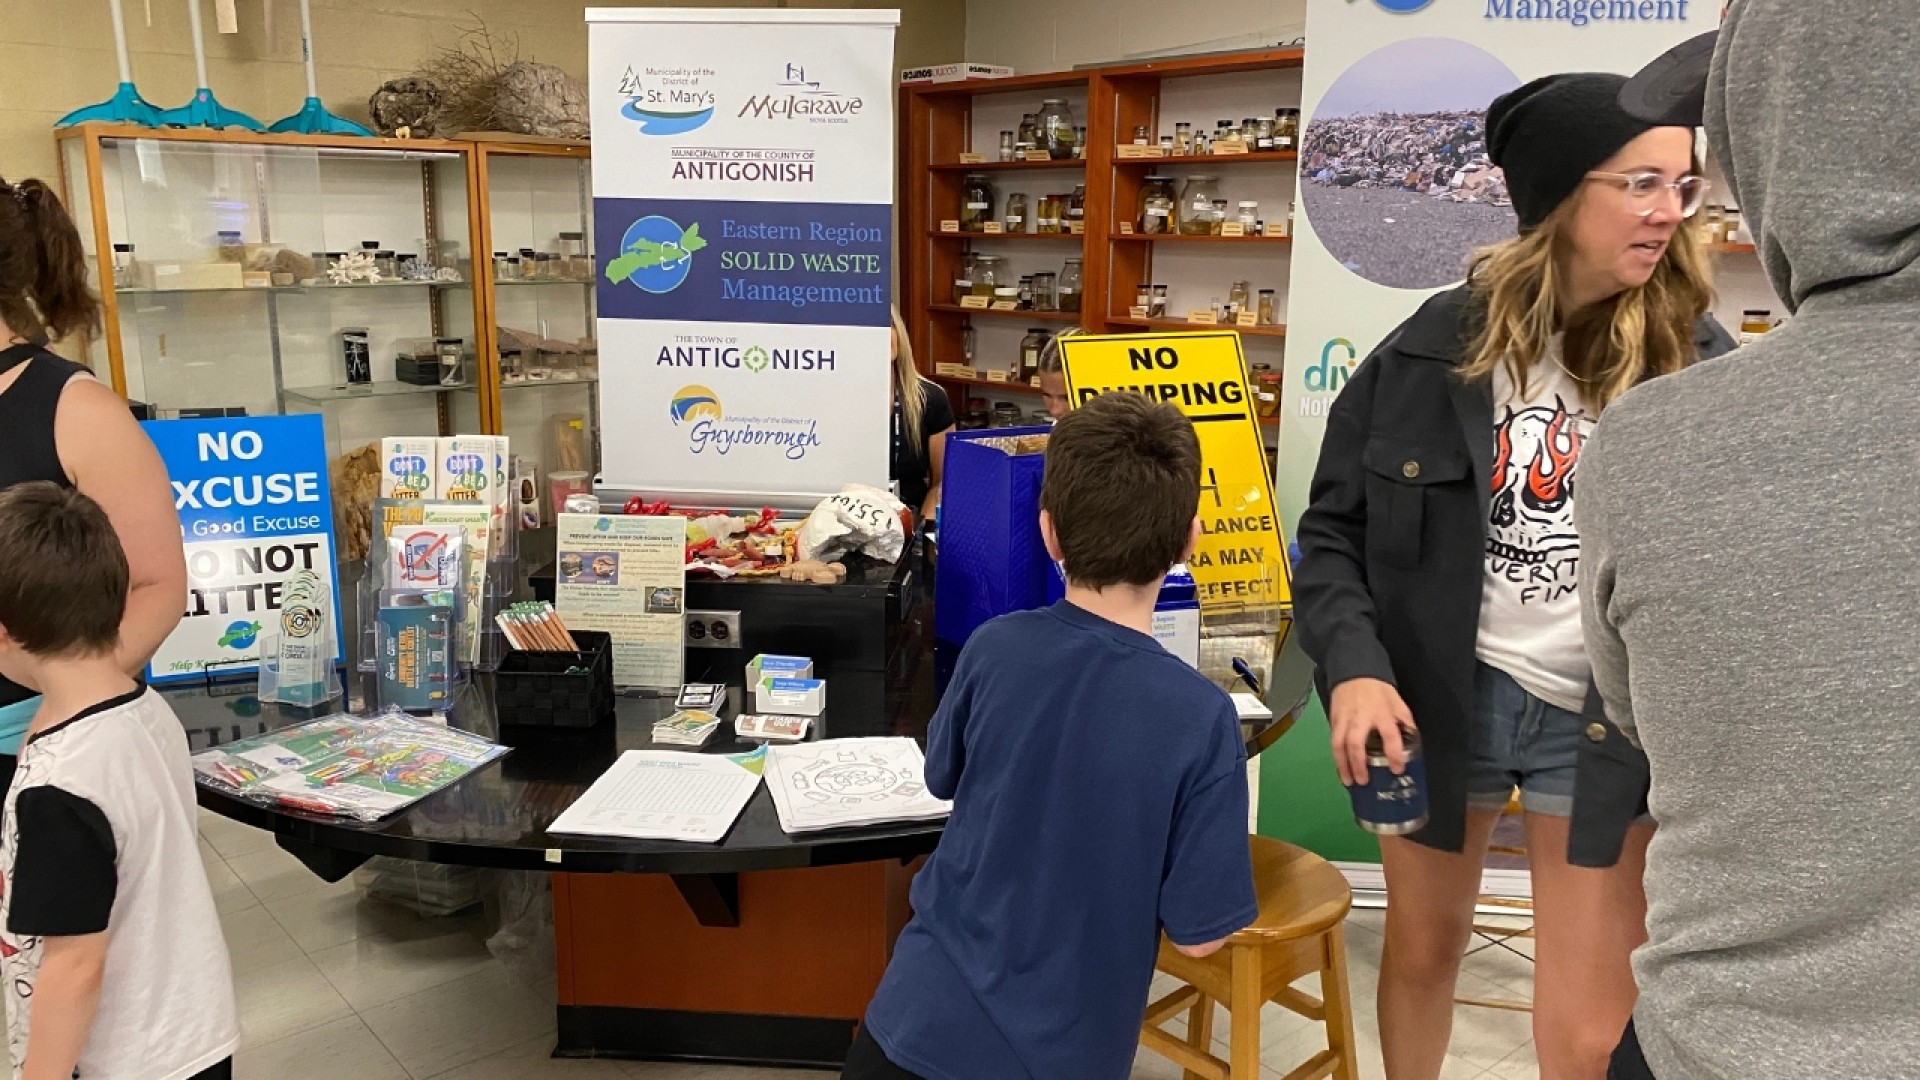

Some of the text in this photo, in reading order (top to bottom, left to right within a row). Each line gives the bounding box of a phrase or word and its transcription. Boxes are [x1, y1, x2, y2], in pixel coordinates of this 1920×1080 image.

[1483, 0, 1688, 26] Management
[646, 67, 715, 77] Municipality of the
[662, 76, 699, 85] District of
[647, 90, 715, 107] St. Mary's
[671, 149, 815, 160] MUNICIPALITY OF THE COUNTY OF
[671, 161, 814, 182] ANTIGONISH
[722, 219, 883, 247] Eastern Region
[720, 251, 880, 274] SOLID WASTE
[721, 278, 884, 307] Management
[674, 335, 738, 344] THE TOWN OF
[1128, 347, 1179, 371] NO
[724, 415, 762, 424] Municipality
[781, 417, 802, 425] District
[197, 430, 263, 462] NO
[689, 420, 820, 460] Guysborough
[170, 471, 321, 511] XCUSE
[383, 506, 405, 521] THE
[192, 517, 246, 536] Good
[252, 514, 321, 532] Excuse
[1199, 515, 1273, 535] LANCE
[189, 542, 319, 580] O NOT
[1218, 546, 1264, 564] MAY
[1489, 558, 1578, 583] VERYT
[183, 581, 283, 617] ITTE
